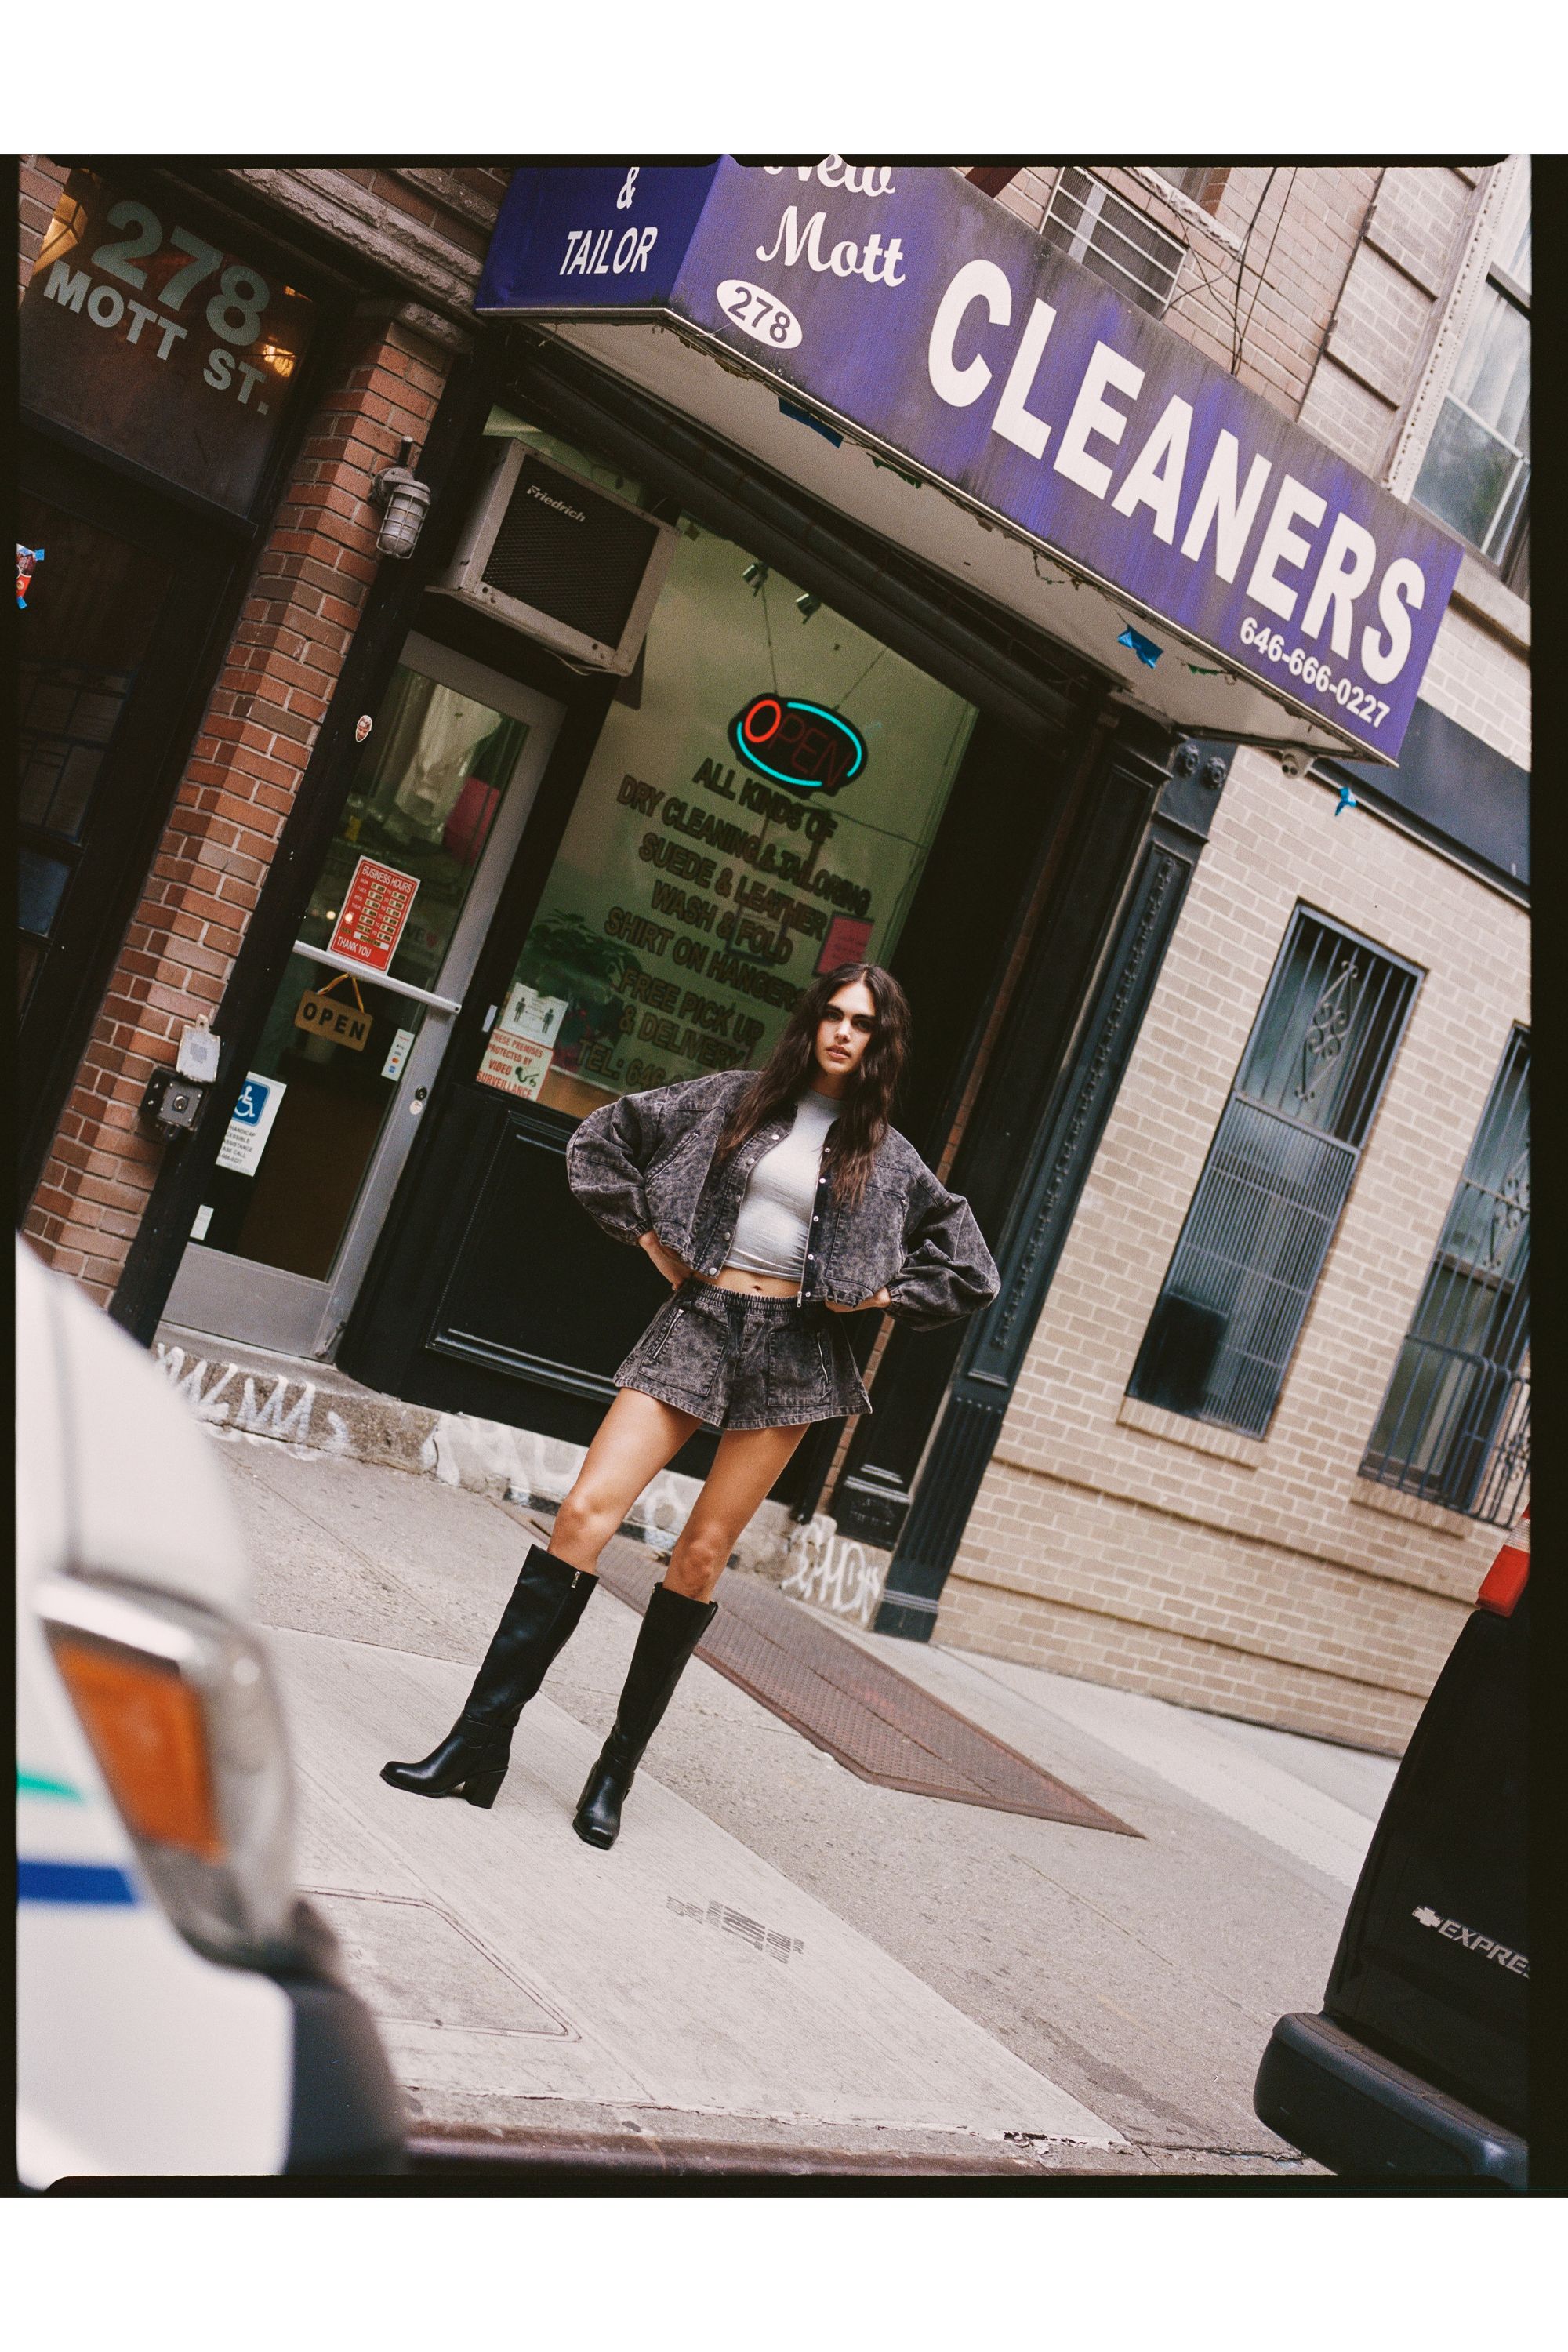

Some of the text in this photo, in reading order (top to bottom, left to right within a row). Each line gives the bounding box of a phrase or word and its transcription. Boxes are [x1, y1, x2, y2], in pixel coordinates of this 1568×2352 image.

[764, 154, 896, 197] ew
[91, 201, 270, 347] 278
[559, 227, 658, 275] TAILOR
[756, 205, 906, 287] Mott
[43, 261, 270, 416] MOTT ST.
[726, 286, 792, 343] 278
[526, 485, 586, 522] Friedrich
[928, 259, 1425, 684] CLEANERS
[1240, 617, 1390, 728] 646-666-0227
[745, 699, 853, 787] OPEN
[692, 757, 838, 843] ALL KINDS OF
[616, 774, 872, 916] DRY CLEANING & TAILORING
[362, 866, 412, 893] BUSINESS HOURS
[638, 832, 828, 941] SUEDE & LEATHER
[337, 936, 372, 958] THANK YOU
[604, 906, 675, 956] SHIRT
[672, 936, 710, 974] ON
[652, 880, 719, 933] WASH
[716, 910, 735, 940] &
[735, 918, 793, 965] FOLD
[303, 1003, 365, 1040] OPEN
[617, 966, 765, 1047] FREE PICK UP
[618, 1004, 745, 1070] & DELIVERY
[488, 1059, 512, 1075] VIDEO
[512, 1039, 544, 1058] PREMISES
[576, 1038, 625, 1080] TEL:
[477, 1071, 533, 1098] SURVEILLANCE
